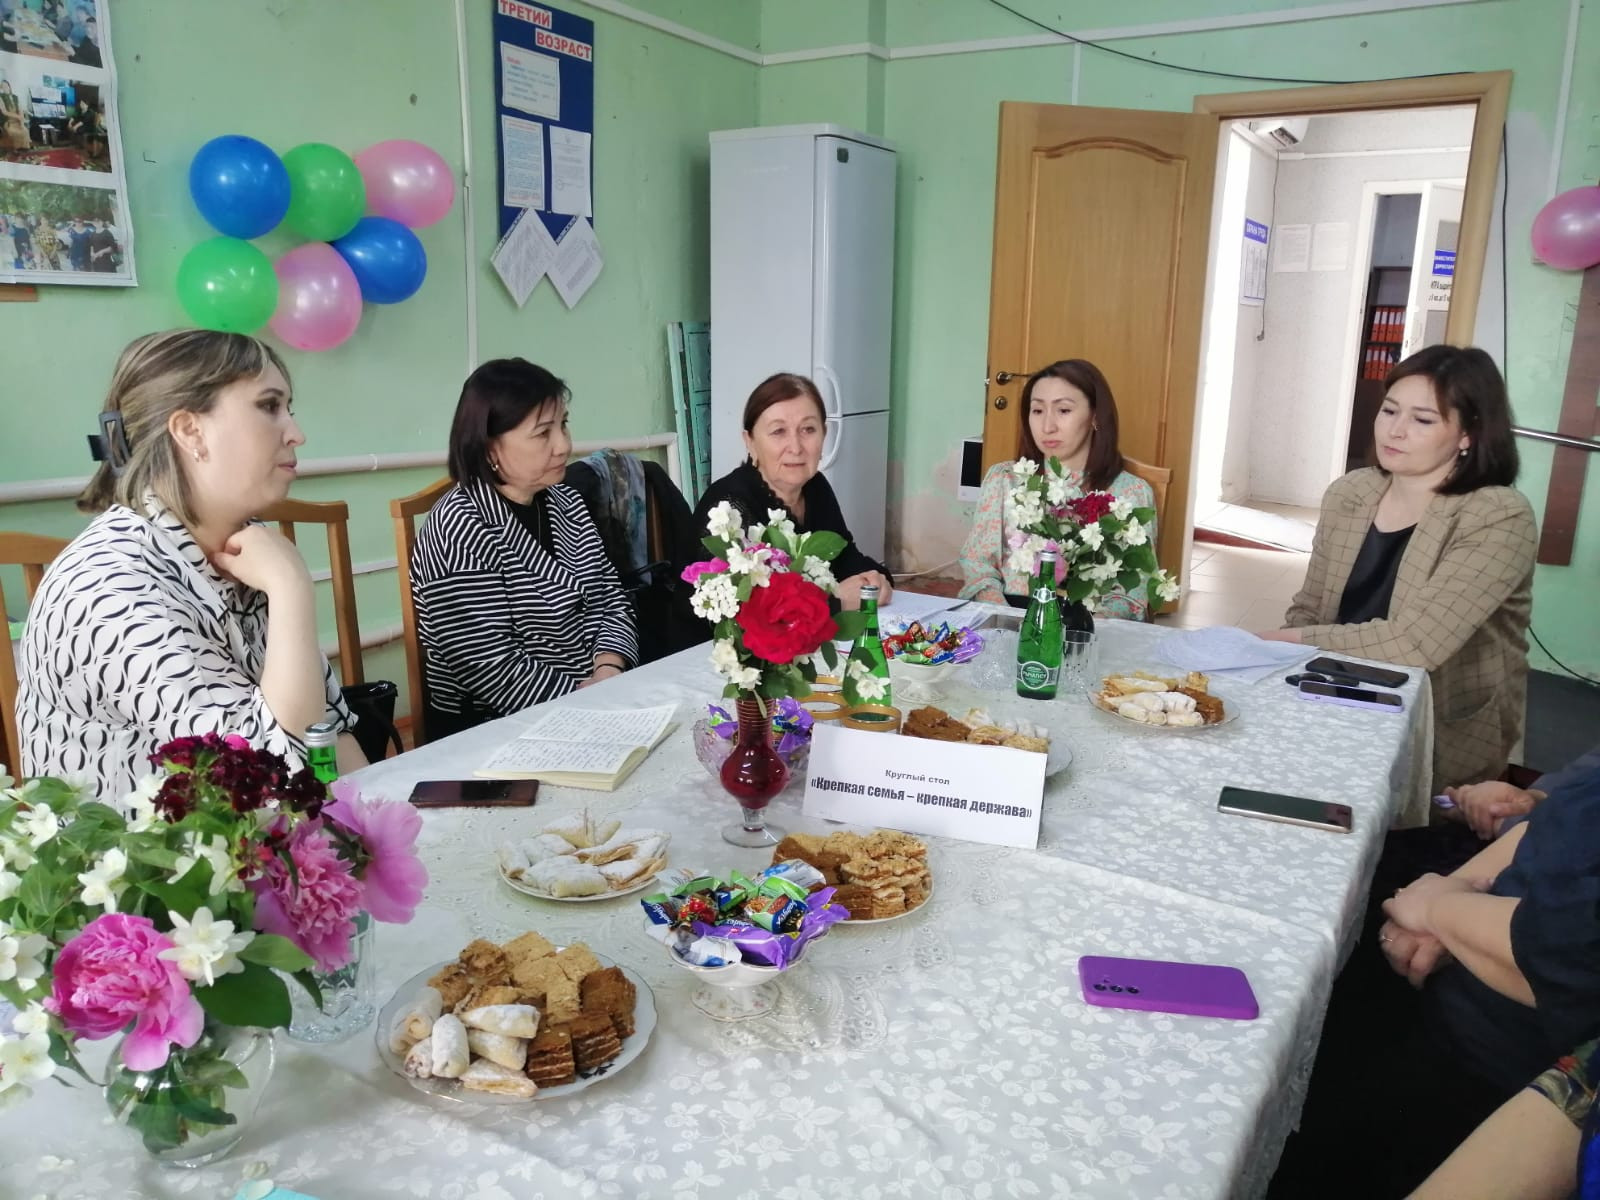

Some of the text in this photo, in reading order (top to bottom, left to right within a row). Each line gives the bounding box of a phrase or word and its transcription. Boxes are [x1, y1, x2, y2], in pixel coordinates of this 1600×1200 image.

[500, 0, 551, 27] ТРЕТИЙ
[536, 31, 592, 59] ВОЗРАСТ
[885, 769, 950, 785] Круглый стол
[811, 776, 865, 795] «Крепкая
[867, 785, 905, 801] семья
[916, 792, 968, 810] крепкая
[969, 800, 1032, 818] держава»
